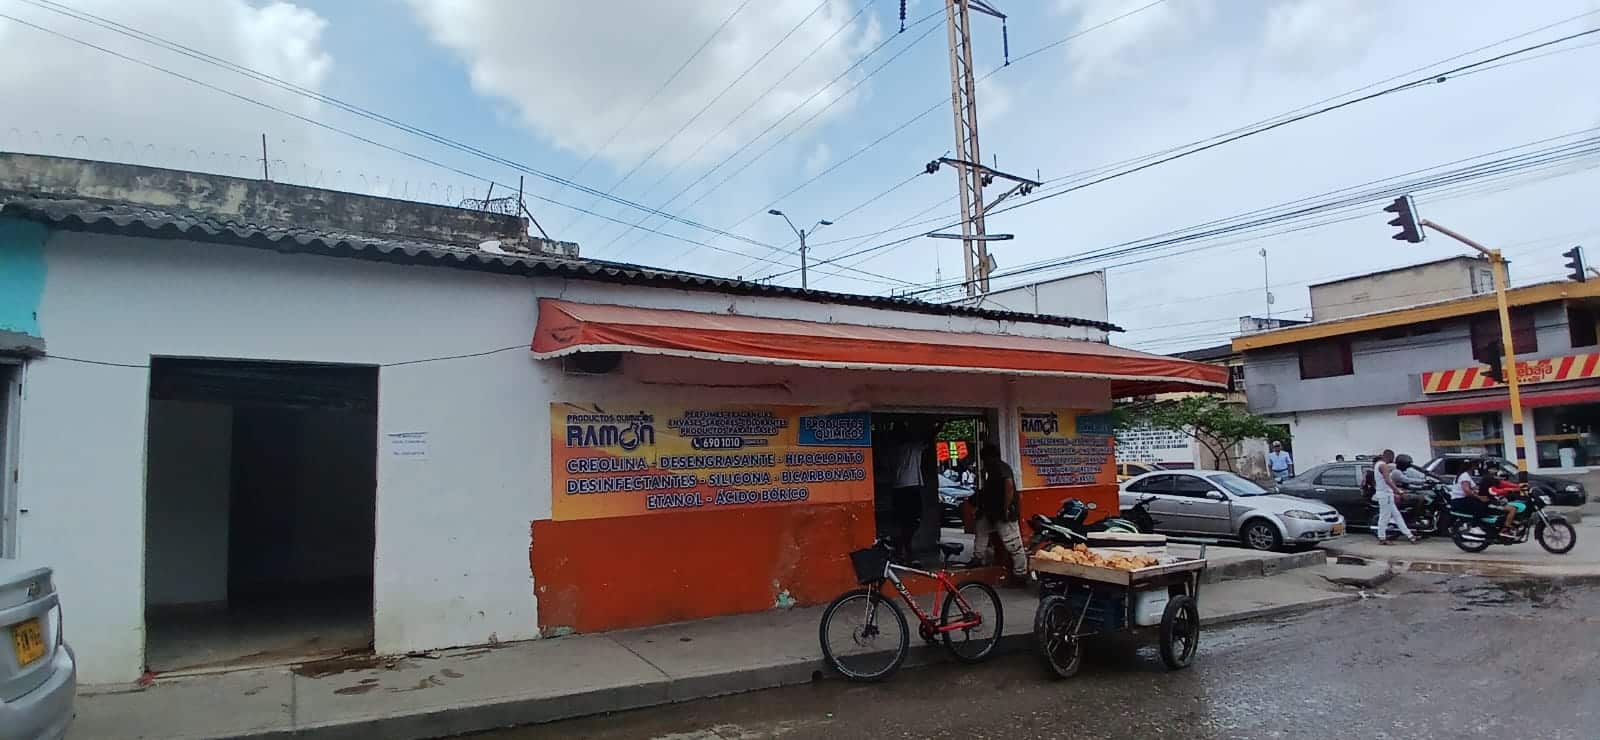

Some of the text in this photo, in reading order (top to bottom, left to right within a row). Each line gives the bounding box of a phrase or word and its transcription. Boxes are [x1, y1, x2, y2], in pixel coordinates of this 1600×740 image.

[1515, 361, 1553, 379] ebaja
[567, 414, 615, 424] PRODUCTOS
[806, 418, 865, 430] PRODUCTOS
[703, 438, 720, 448] 690
[721, 438, 740, 448] 1010
[567, 457, 648, 473] CREOLINA
[658, 453, 775, 470] DESENGRASANTE
[785, 452, 864, 467] HIPOCLORITO
[566, 474, 698, 494] DESINFECTANTES
[708, 472, 771, 487] SILICONA
[781, 469, 866, 483] BICARBONATO
[647, 492, 704, 509] ETANOL
[715, 488, 758, 504] ÁCIDO
[761, 487, 809, 501] BÓRICO
